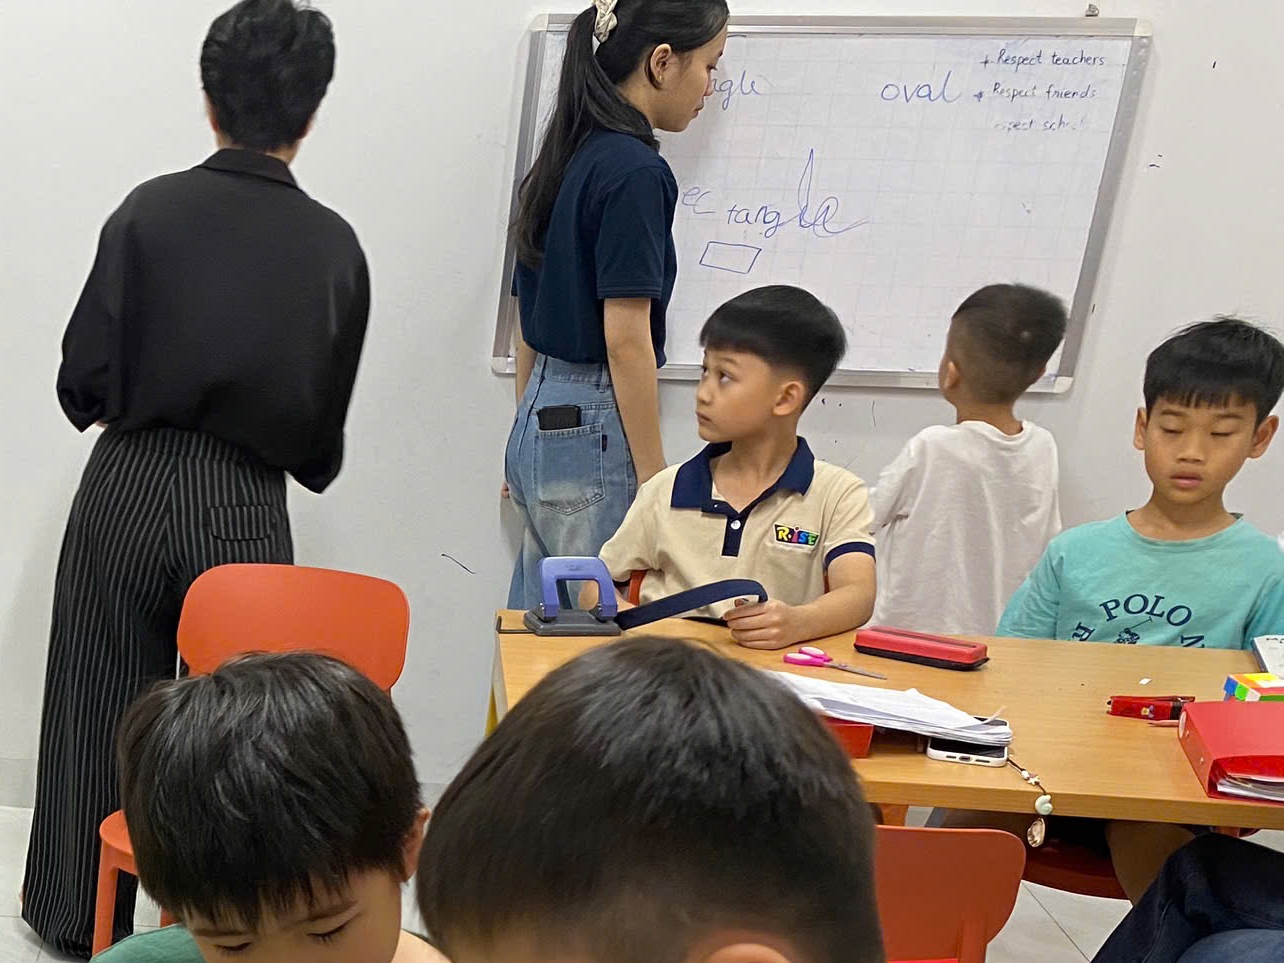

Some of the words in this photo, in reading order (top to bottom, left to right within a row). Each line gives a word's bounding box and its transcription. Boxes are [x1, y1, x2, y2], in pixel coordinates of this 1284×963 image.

[997, 49, 1042, 72] Respect
[1052, 50, 1105, 66] teachers
[880, 70, 960, 103] oval
[993, 82, 1037, 102] Respect
[1046, 84, 1096, 99] friends
[1099, 594, 1192, 626] POLO
